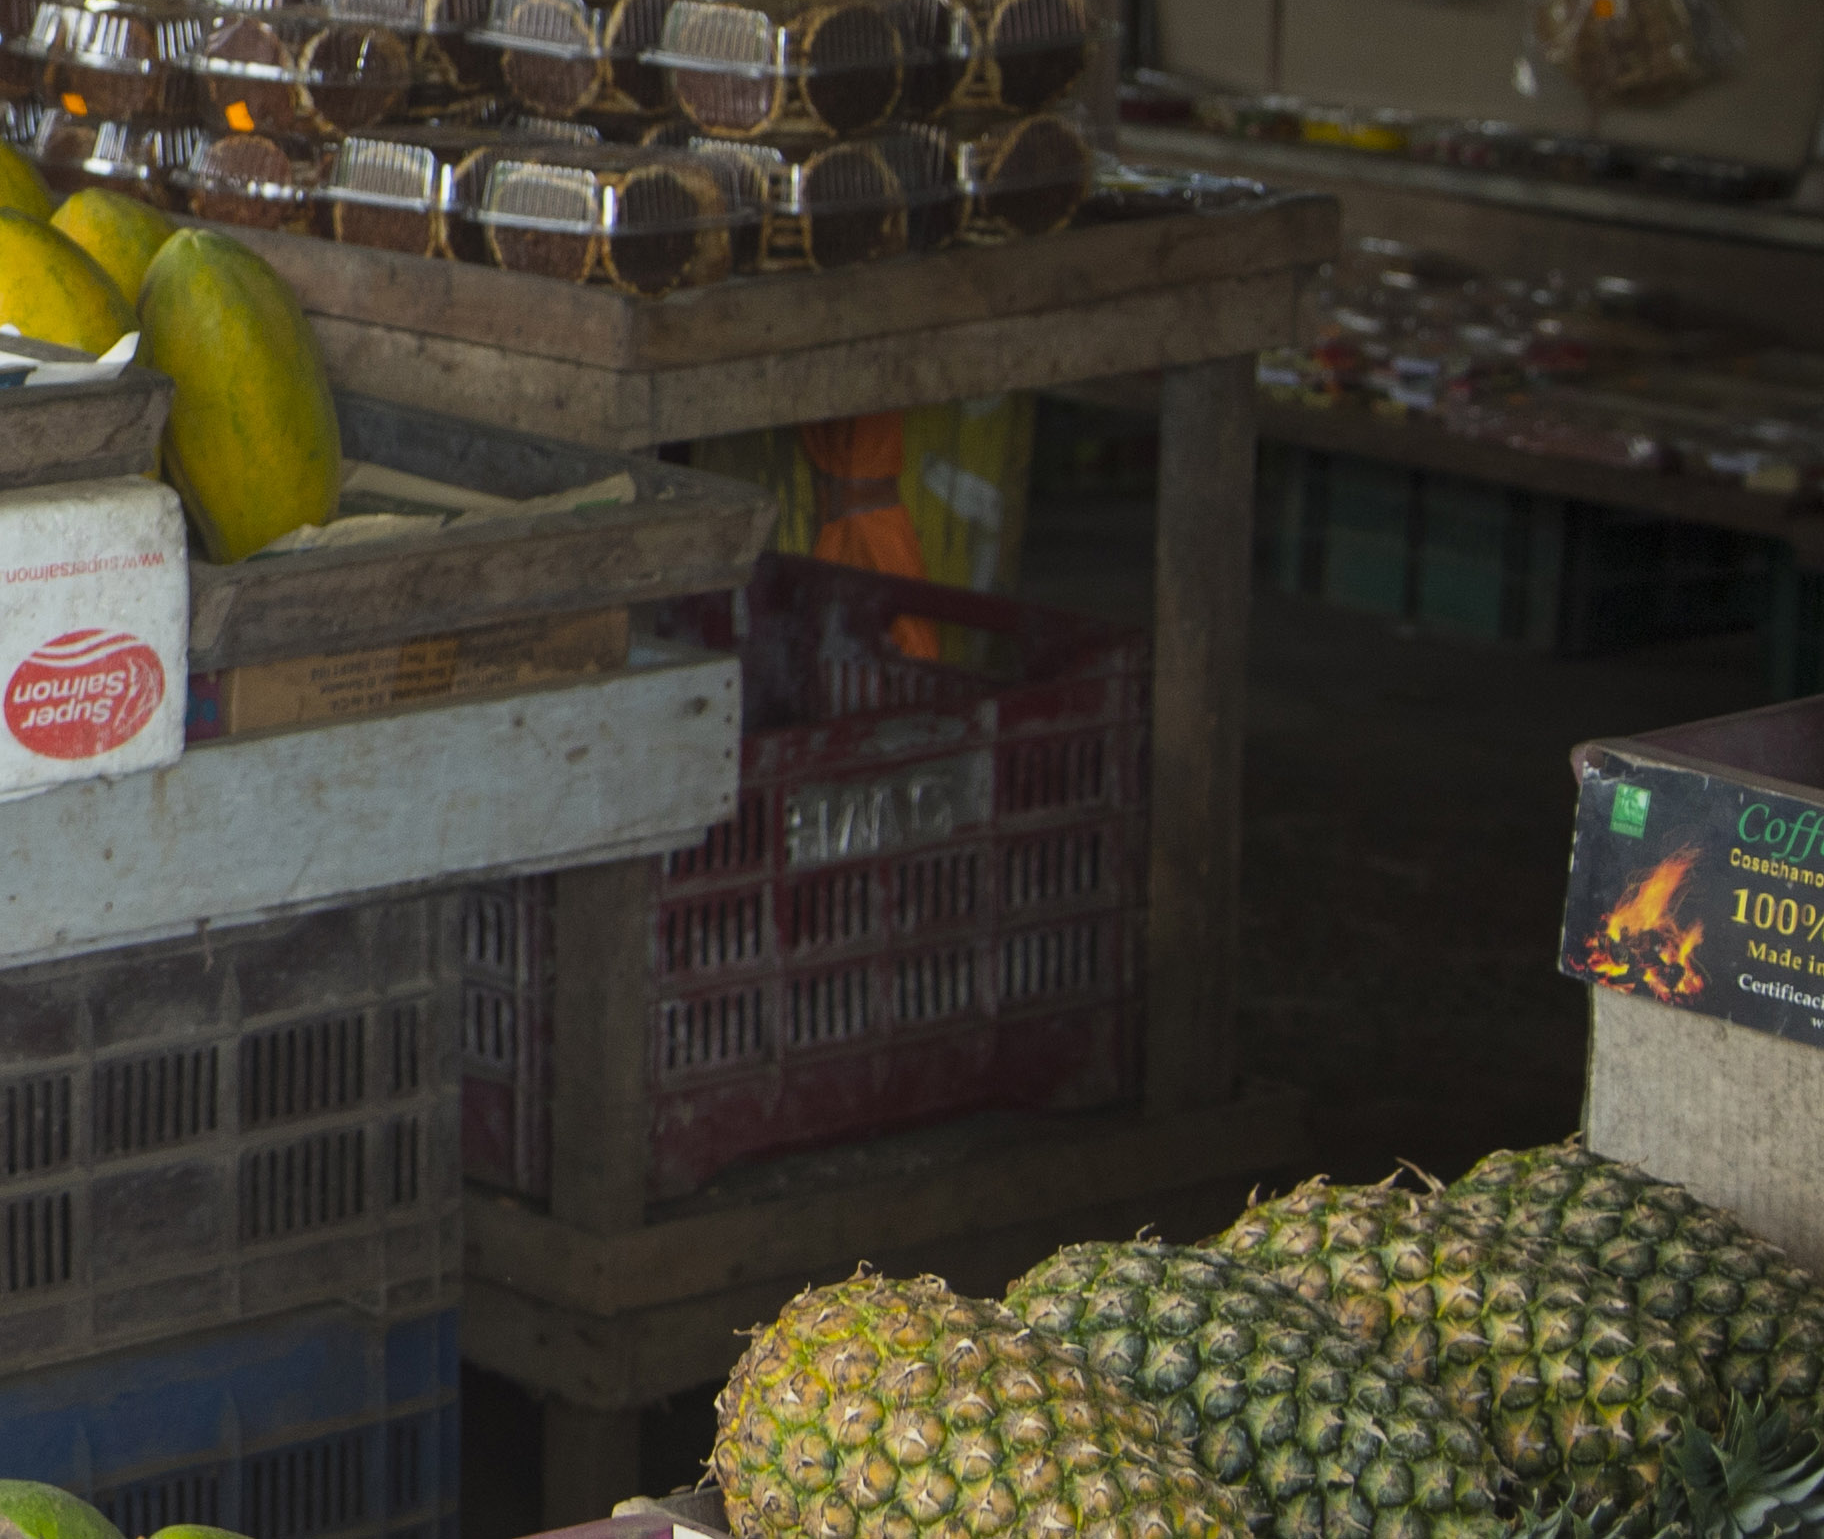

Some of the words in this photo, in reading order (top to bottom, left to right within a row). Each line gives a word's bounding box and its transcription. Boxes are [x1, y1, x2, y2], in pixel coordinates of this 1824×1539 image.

[12, 670, 128, 705] Salmon
[20, 695, 114, 732] Super
[1737, 802, 1824, 863] Coff
[1747, 939, 1803, 971] Made
